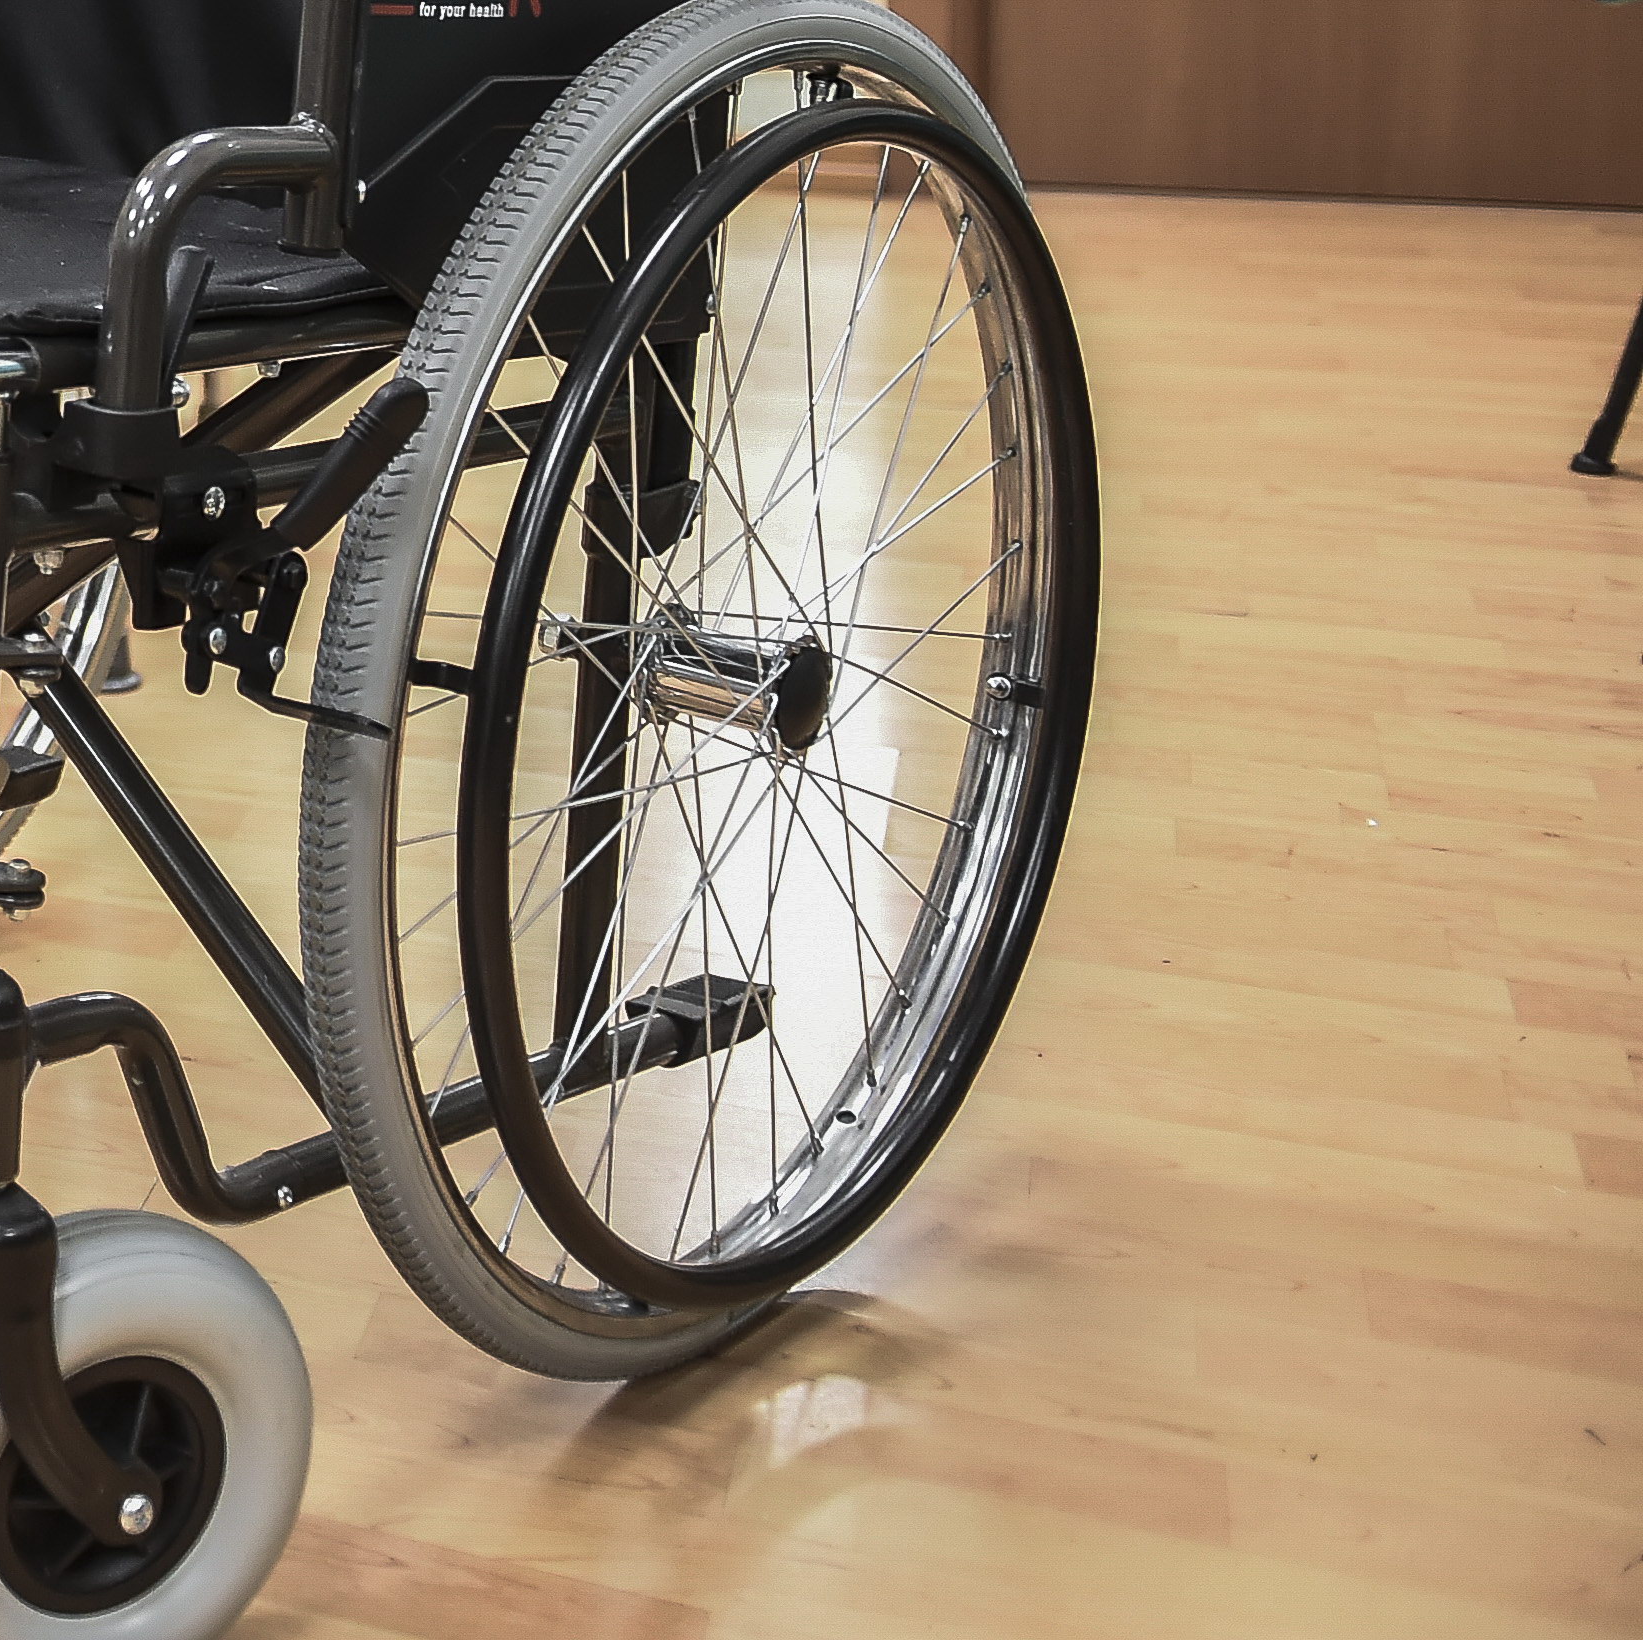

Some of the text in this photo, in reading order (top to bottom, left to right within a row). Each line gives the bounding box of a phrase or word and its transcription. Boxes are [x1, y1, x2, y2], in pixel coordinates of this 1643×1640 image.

[419, 1, 504, 20] for your health
